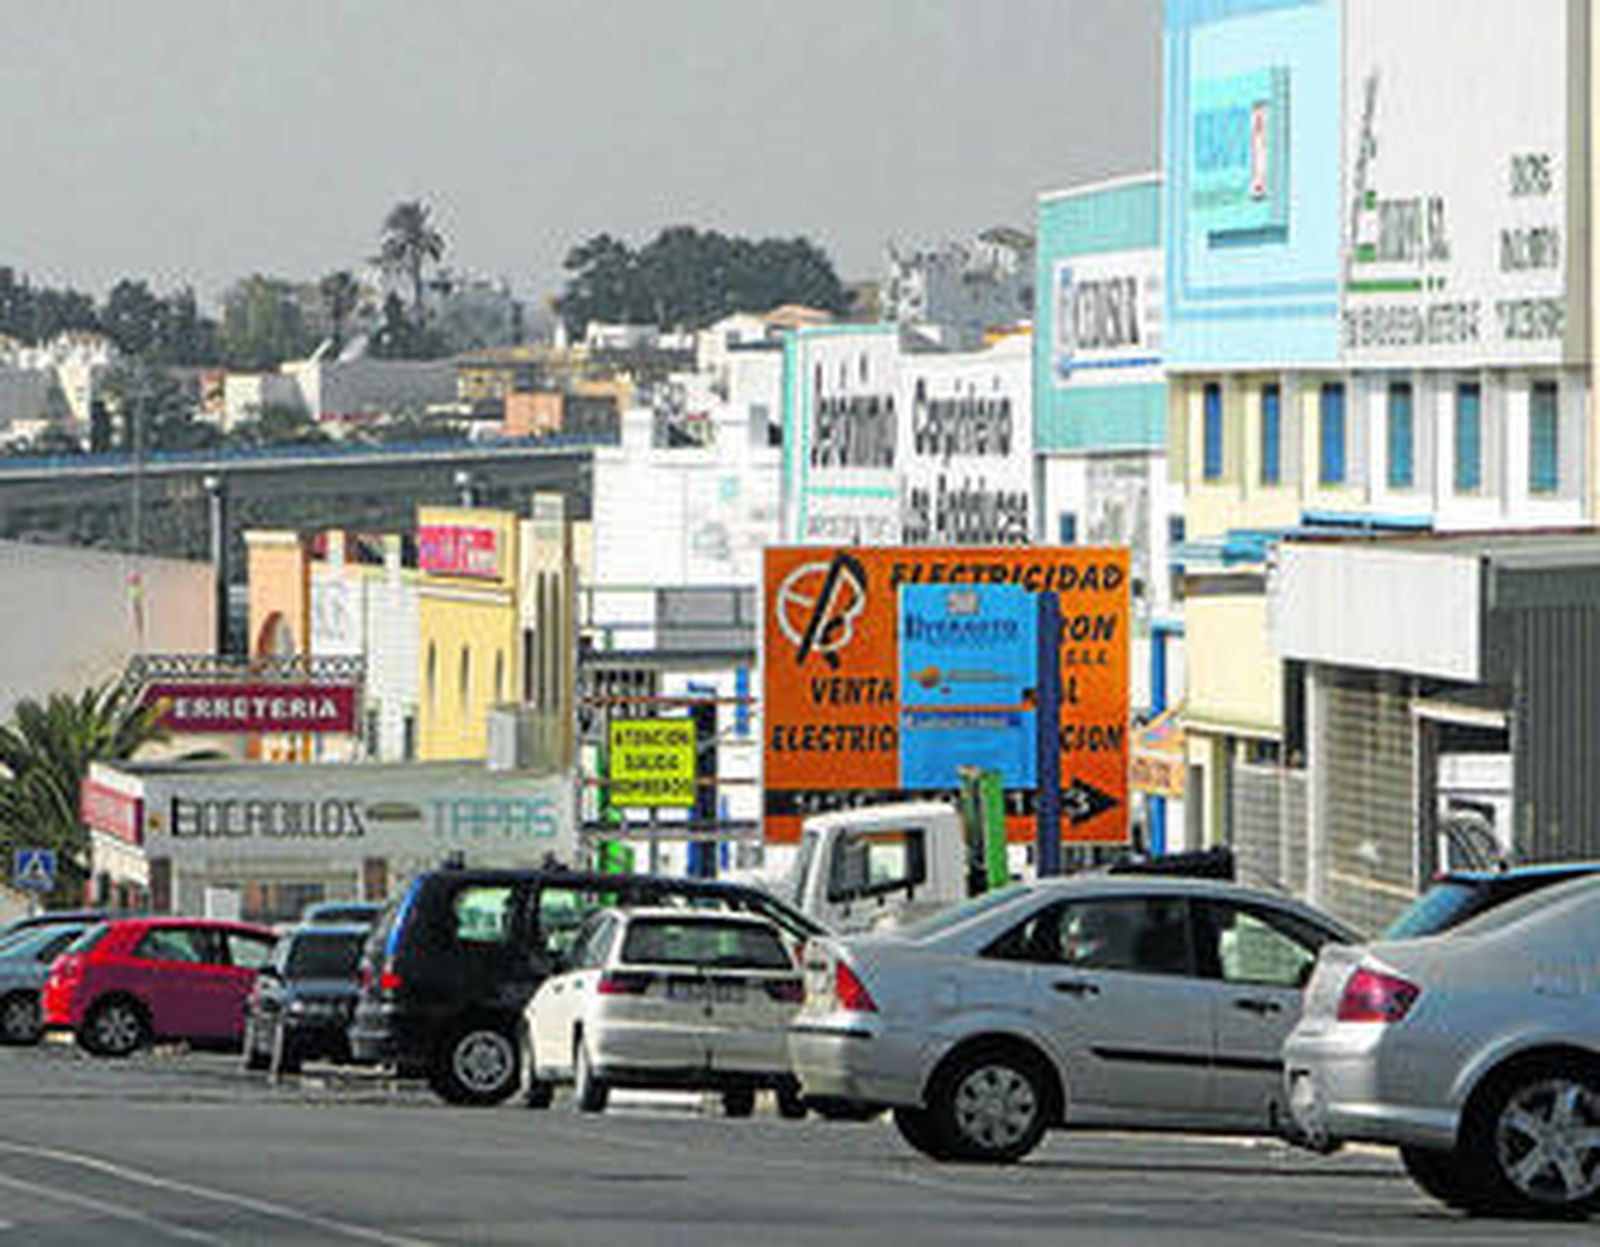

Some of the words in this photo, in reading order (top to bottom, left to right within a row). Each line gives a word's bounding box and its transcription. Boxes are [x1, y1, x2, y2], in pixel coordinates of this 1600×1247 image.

[891, 563, 1123, 591] ELECTRICIDAD
[812, 677, 894, 704] VENTA
[174, 698, 338, 720] ERRETERIA
[772, 725, 899, 752] ELECTRIC
[171, 795, 364, 838] BOCADILLOS
[429, 797, 558, 838] TAPAS
